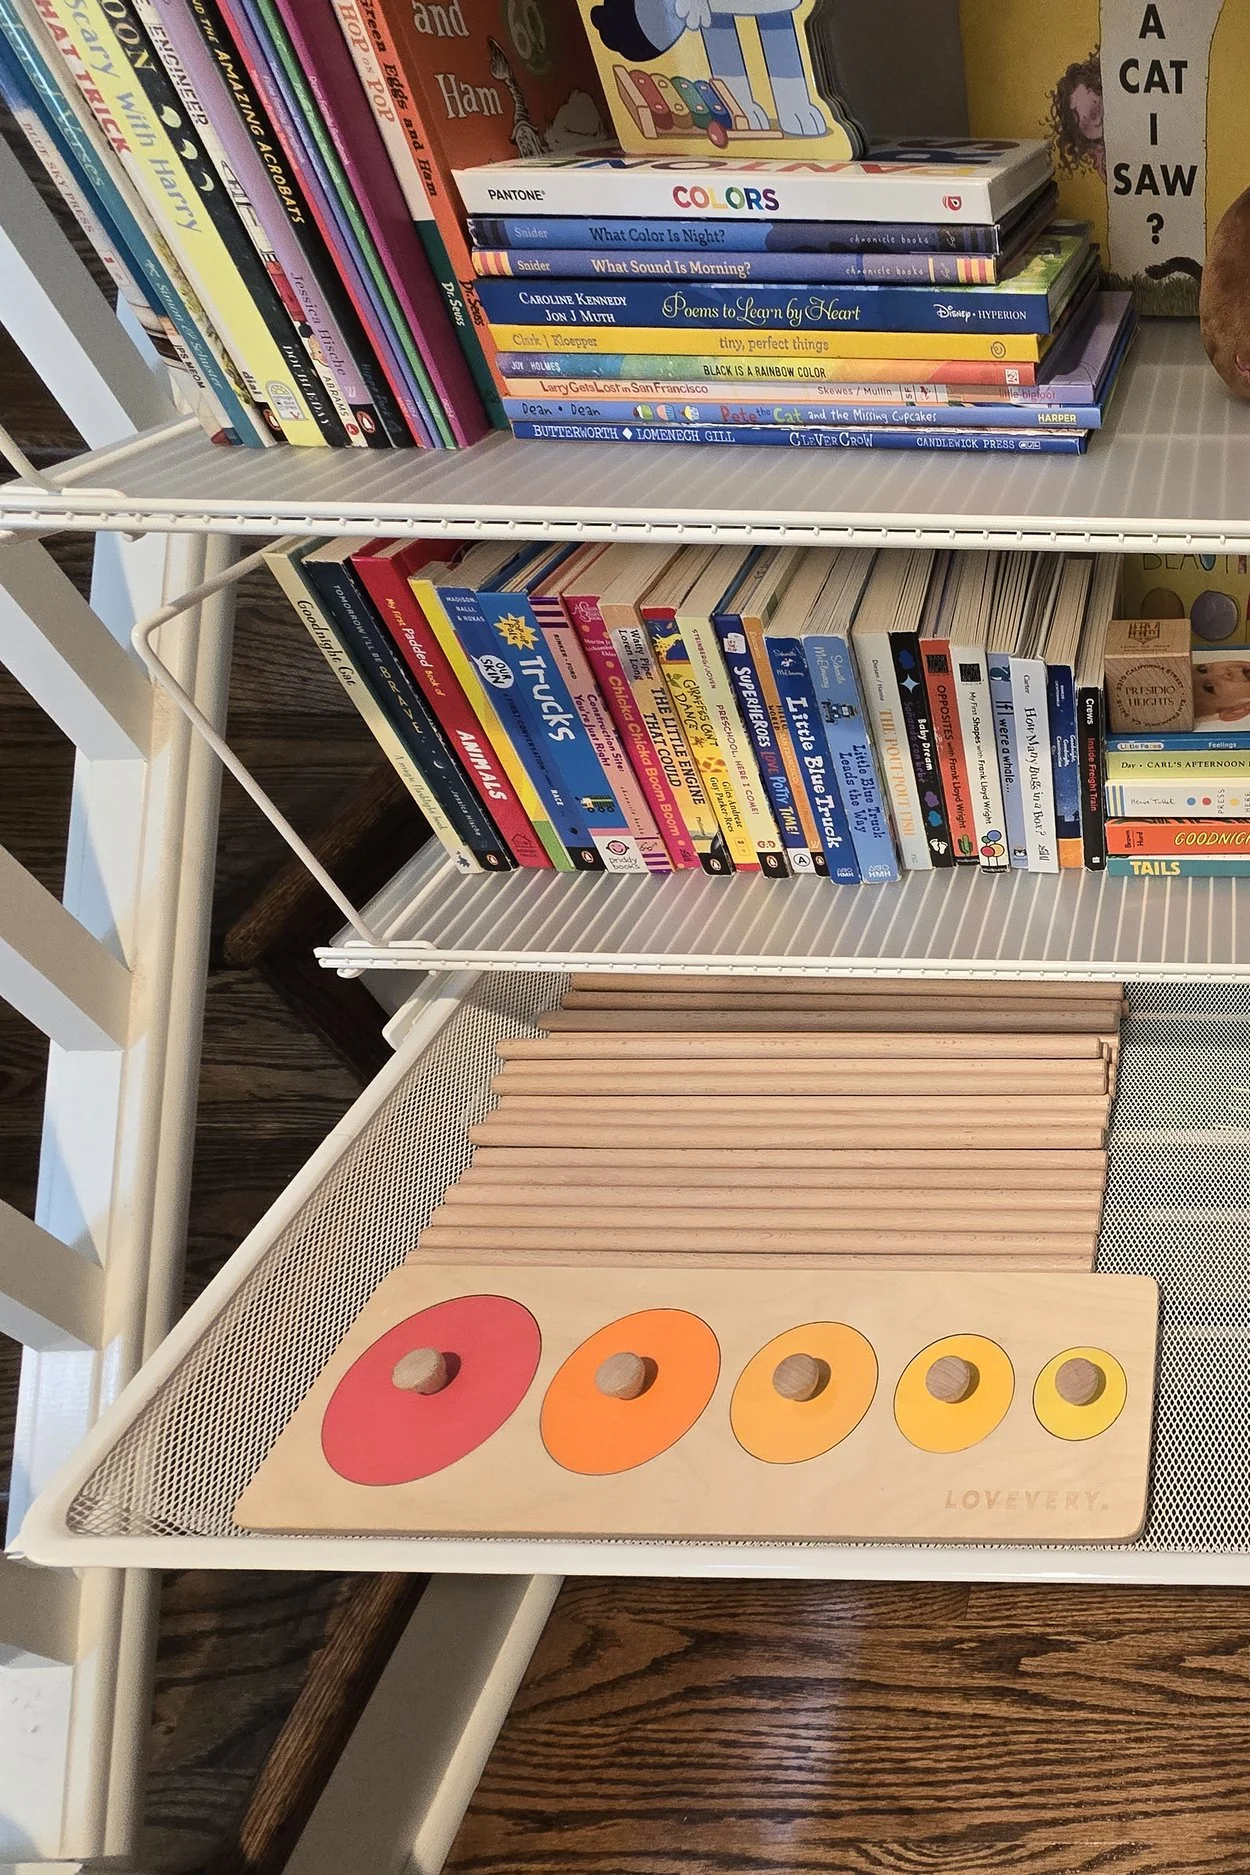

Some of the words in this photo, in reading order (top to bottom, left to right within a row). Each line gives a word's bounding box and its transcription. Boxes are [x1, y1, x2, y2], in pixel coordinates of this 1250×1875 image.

[413, 0, 472, 38] and
[1138, 3, 1167, 40] A
[1118, 58, 1188, 95] CAT
[434, 73, 505, 120] Ham
[75, 70, 133, 155] TRICK
[213, 48, 263, 146] AMAZING
[256, 143, 305, 225] ACROBATS
[383, 63, 406, 112] Eggs
[402, 115, 424, 153] and
[417, 158, 440, 199] Ham
[1149, 112, 1159, 146] I
[1112, 162, 1198, 198] SAW
[148, 158, 203, 234] Harry
[672, 185, 781, 213] COLORS
[514, 227, 549, 240] Snider
[589, 226, 626, 243] What
[628, 227, 665, 244] Color
[666, 229, 681, 244] Is
[682, 229, 726, 246] Night?
[848, 234, 896, 246] chronicle
[900, 234, 930, 246] books
[1146, 212, 1165, 246] ?
[516, 259, 550, 274] Snider
[590, 259, 629, 275] What
[630, 259, 672, 275] Sound
[673, 260, 687, 275] Is
[688, 260, 752, 279] Morning?
[845, 264, 892, 278] chronicle
[895, 264, 925, 277] books
[661, 291, 720, 319] Poems
[721, 300, 737, 319] to
[736, 296, 784, 327] Learn
[785, 299, 803, 328] by
[804, 295, 862, 322] Heart
[934, 303, 973, 323] Disney
[977, 309, 1028, 321] HYPERION
[511, 333, 543, 348] Clark
[551, 334, 598, 349] Kloepper
[718, 336, 746, 352] tiny,
[747, 337, 790, 352] perfect
[792, 336, 830, 352] things
[242, 371, 265, 396] dial
[702, 364, 733, 378] BLACK
[734, 365, 745, 378] IS
[755, 365, 795, 379] RAINBOW
[797, 366, 827, 380] COLOR
[323, 376, 349, 418] ABRAMS
[521, 402, 553, 416] Dean
[570, 402, 602, 417] Dean
[719, 404, 758, 425] Pete
[756, 406, 772, 418] the
[772, 406, 801, 424] Cat
[807, 411, 829, 423] and
[830, 409, 850, 423] the
[852, 408, 888, 426] Missing
[890, 410, 938, 427] Cupcakes
[1037, 412, 1078, 424] HARPER
[532, 424, 619, 441] BUTTERWORTH
[636, 427, 702, 443] LOMENECH
[704, 430, 736, 444] GILL
[916, 436, 979, 450] CANDLEWICK
[982, 438, 1016, 450] PRESS
[402, 627, 435, 669] Padded
[480, 657, 505, 686] SKIN
[1125, 685, 1177, 696] PRESIDIO
[1128, 697, 1175, 707] HEIGHTS
[674, 692, 700, 732] DANCE
[784, 696, 815, 753] Little
[608, 675, 635, 723] Chicka
[627, 723, 652, 766] Chicka
[643, 766, 668, 803] Boom
[659, 802, 682, 837] Boom
[643, 712, 667, 746] THAT
[658, 747, 683, 788] COULD
[650, 686, 672, 716] THE
[662, 714, 688, 759] LITTLE
[680, 758, 707, 806] ENGINE
[732, 665, 772, 749] SUPERHEROES
[760, 750, 780, 775] LOVE
[777, 806, 801, 836] TIME!
[1207, 741, 1238, 749] Feelings
[803, 755, 826, 795] Blue
[1121, 761, 1137, 769] Day
[1147, 760, 1182, 769] CARL'S
[1185, 760, 1246, 769] AFTERNOON
[814, 794, 843, 849] Truck
[1130, 860, 1182, 876] TAILS
